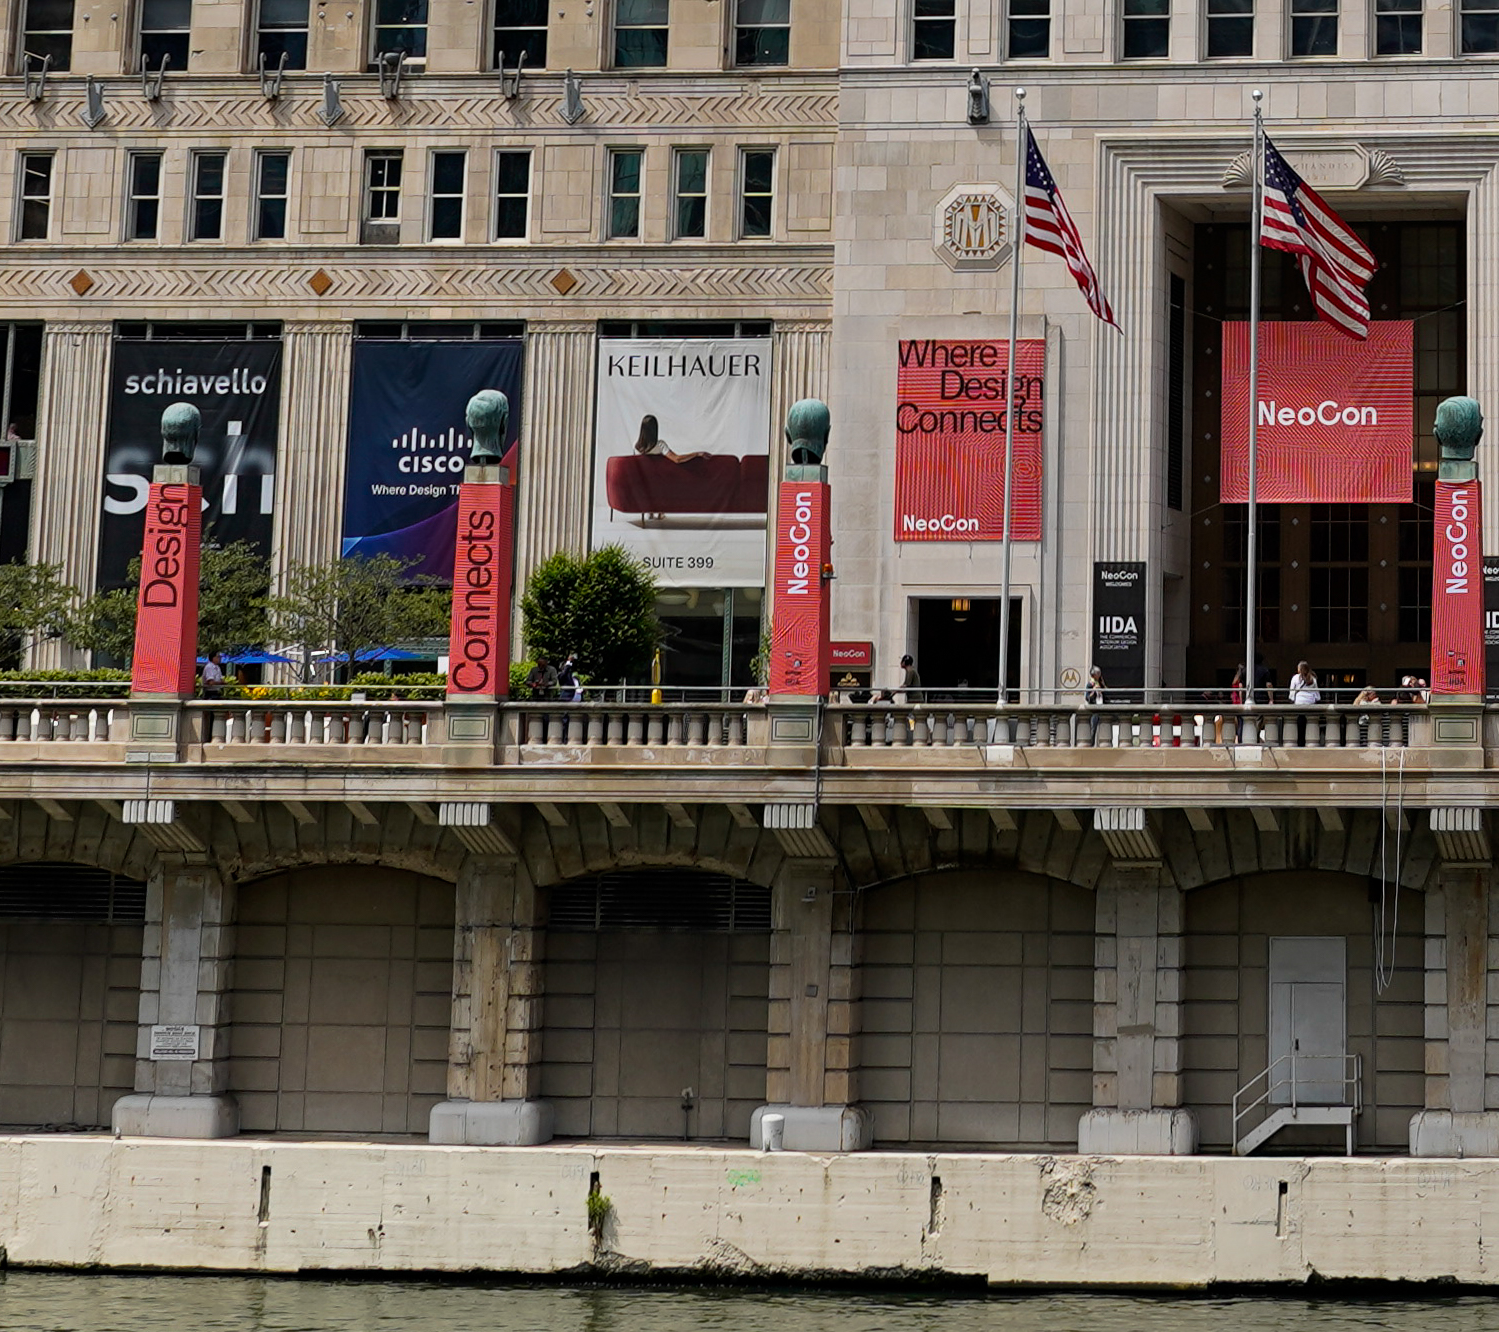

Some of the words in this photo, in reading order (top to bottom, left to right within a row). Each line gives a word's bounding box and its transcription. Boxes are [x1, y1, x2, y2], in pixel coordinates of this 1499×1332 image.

[898, 339, 997, 368] Where
[608, 354, 761, 377] KEILHAUER
[124, 367, 267, 395] schiavello
[1257, 400, 1378, 426] NeoCon
[398, 455, 465, 473] CISCO
[371, 484, 407, 495] Where
[409, 484, 446, 498] Design
[903, 514, 979, 532] NeoCon
[143, 483, 189, 607] Design
[787, 492, 812, 595] NeoCon
[1446, 490, 1468, 594] NeoCon
[642, 556, 684, 569] SUITE
[687, 556, 714, 569] 399
[1101, 570, 1138, 580] NeoCon
[452, 510, 496, 692] Connects
[1099, 616, 1138, 634] IIDA
[832, 649, 866, 658] NeoCon
